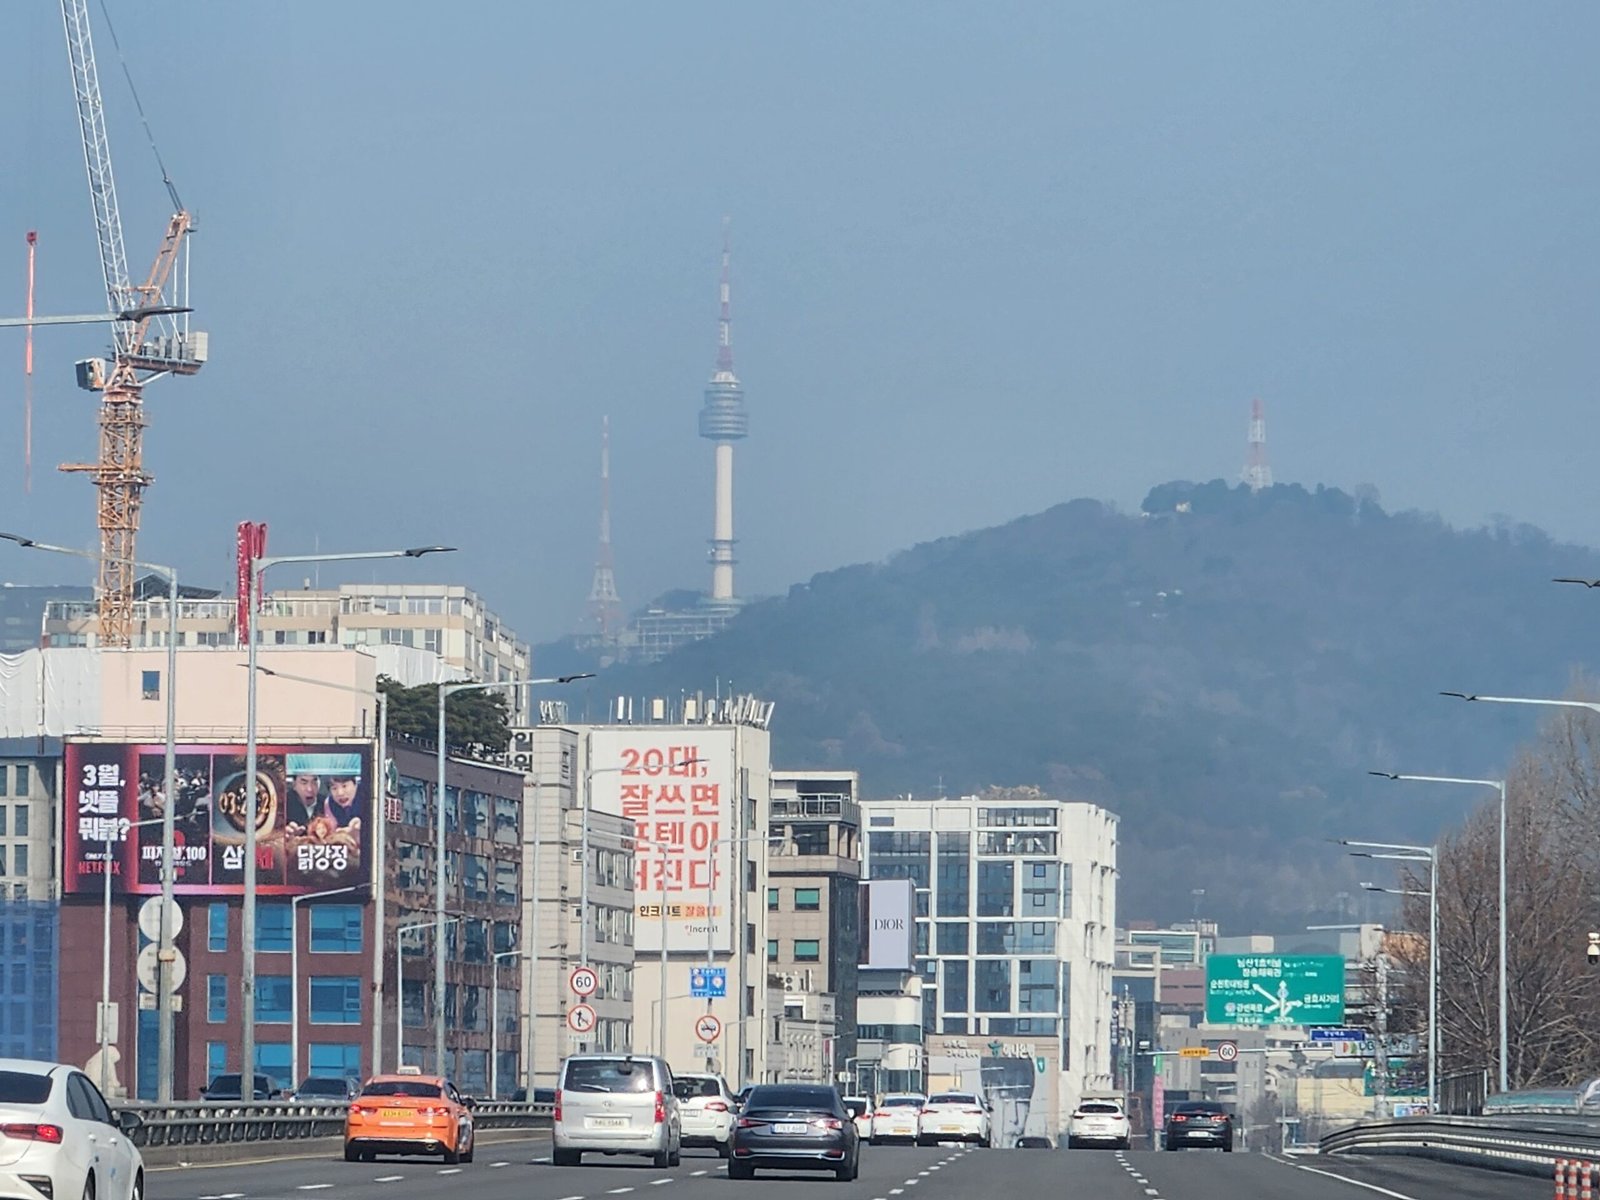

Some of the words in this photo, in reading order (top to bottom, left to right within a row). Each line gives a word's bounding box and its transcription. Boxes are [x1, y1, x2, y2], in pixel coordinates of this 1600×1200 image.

[620, 745, 708, 778] 20대,
[82, 764, 126, 787] 3월,
[78, 790, 119, 814] 넷플
[620, 783, 720, 817] 잘쓰면
[78, 860, 121, 875] NETFX
[297, 845, 348, 871] 닭강정
[874, 918, 904, 930] DIOR
[576, 976, 592, 988] 60
[1221, 1046, 1234, 1056] 60
